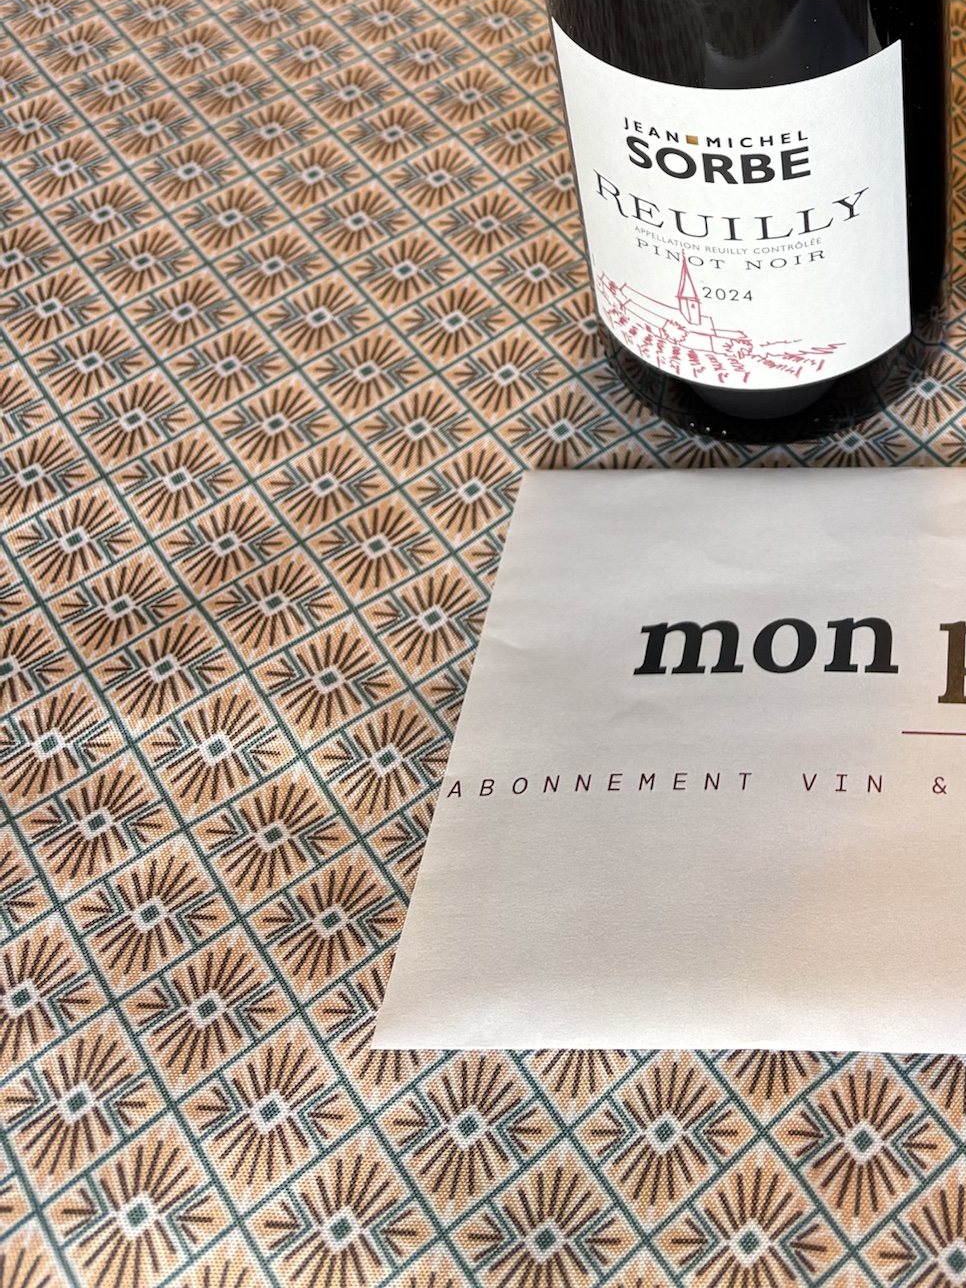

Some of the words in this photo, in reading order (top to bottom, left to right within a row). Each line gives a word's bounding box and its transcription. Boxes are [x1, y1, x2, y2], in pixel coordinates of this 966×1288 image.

[624, 117, 679, 143] JEAN
[706, 130, 808, 148] MICHEL
[626, 135, 811, 185] SORBE
[593, 169, 870, 241] REUILLY
[635, 225, 700, 251] APPELLATION
[704, 245, 749, 255] REUILLY
[753, 237, 822, 255] CONTRÔLÉE
[635, 238, 725, 269] PINOT
[745, 250, 826, 271] NOIR
[702, 287, 754, 302] 2024
[633, 616, 898, 675] mon
[447, 772, 752, 799] ABONNEMENT
[802, 773, 883, 793] VIN
[932, 776, 948, 795] &
